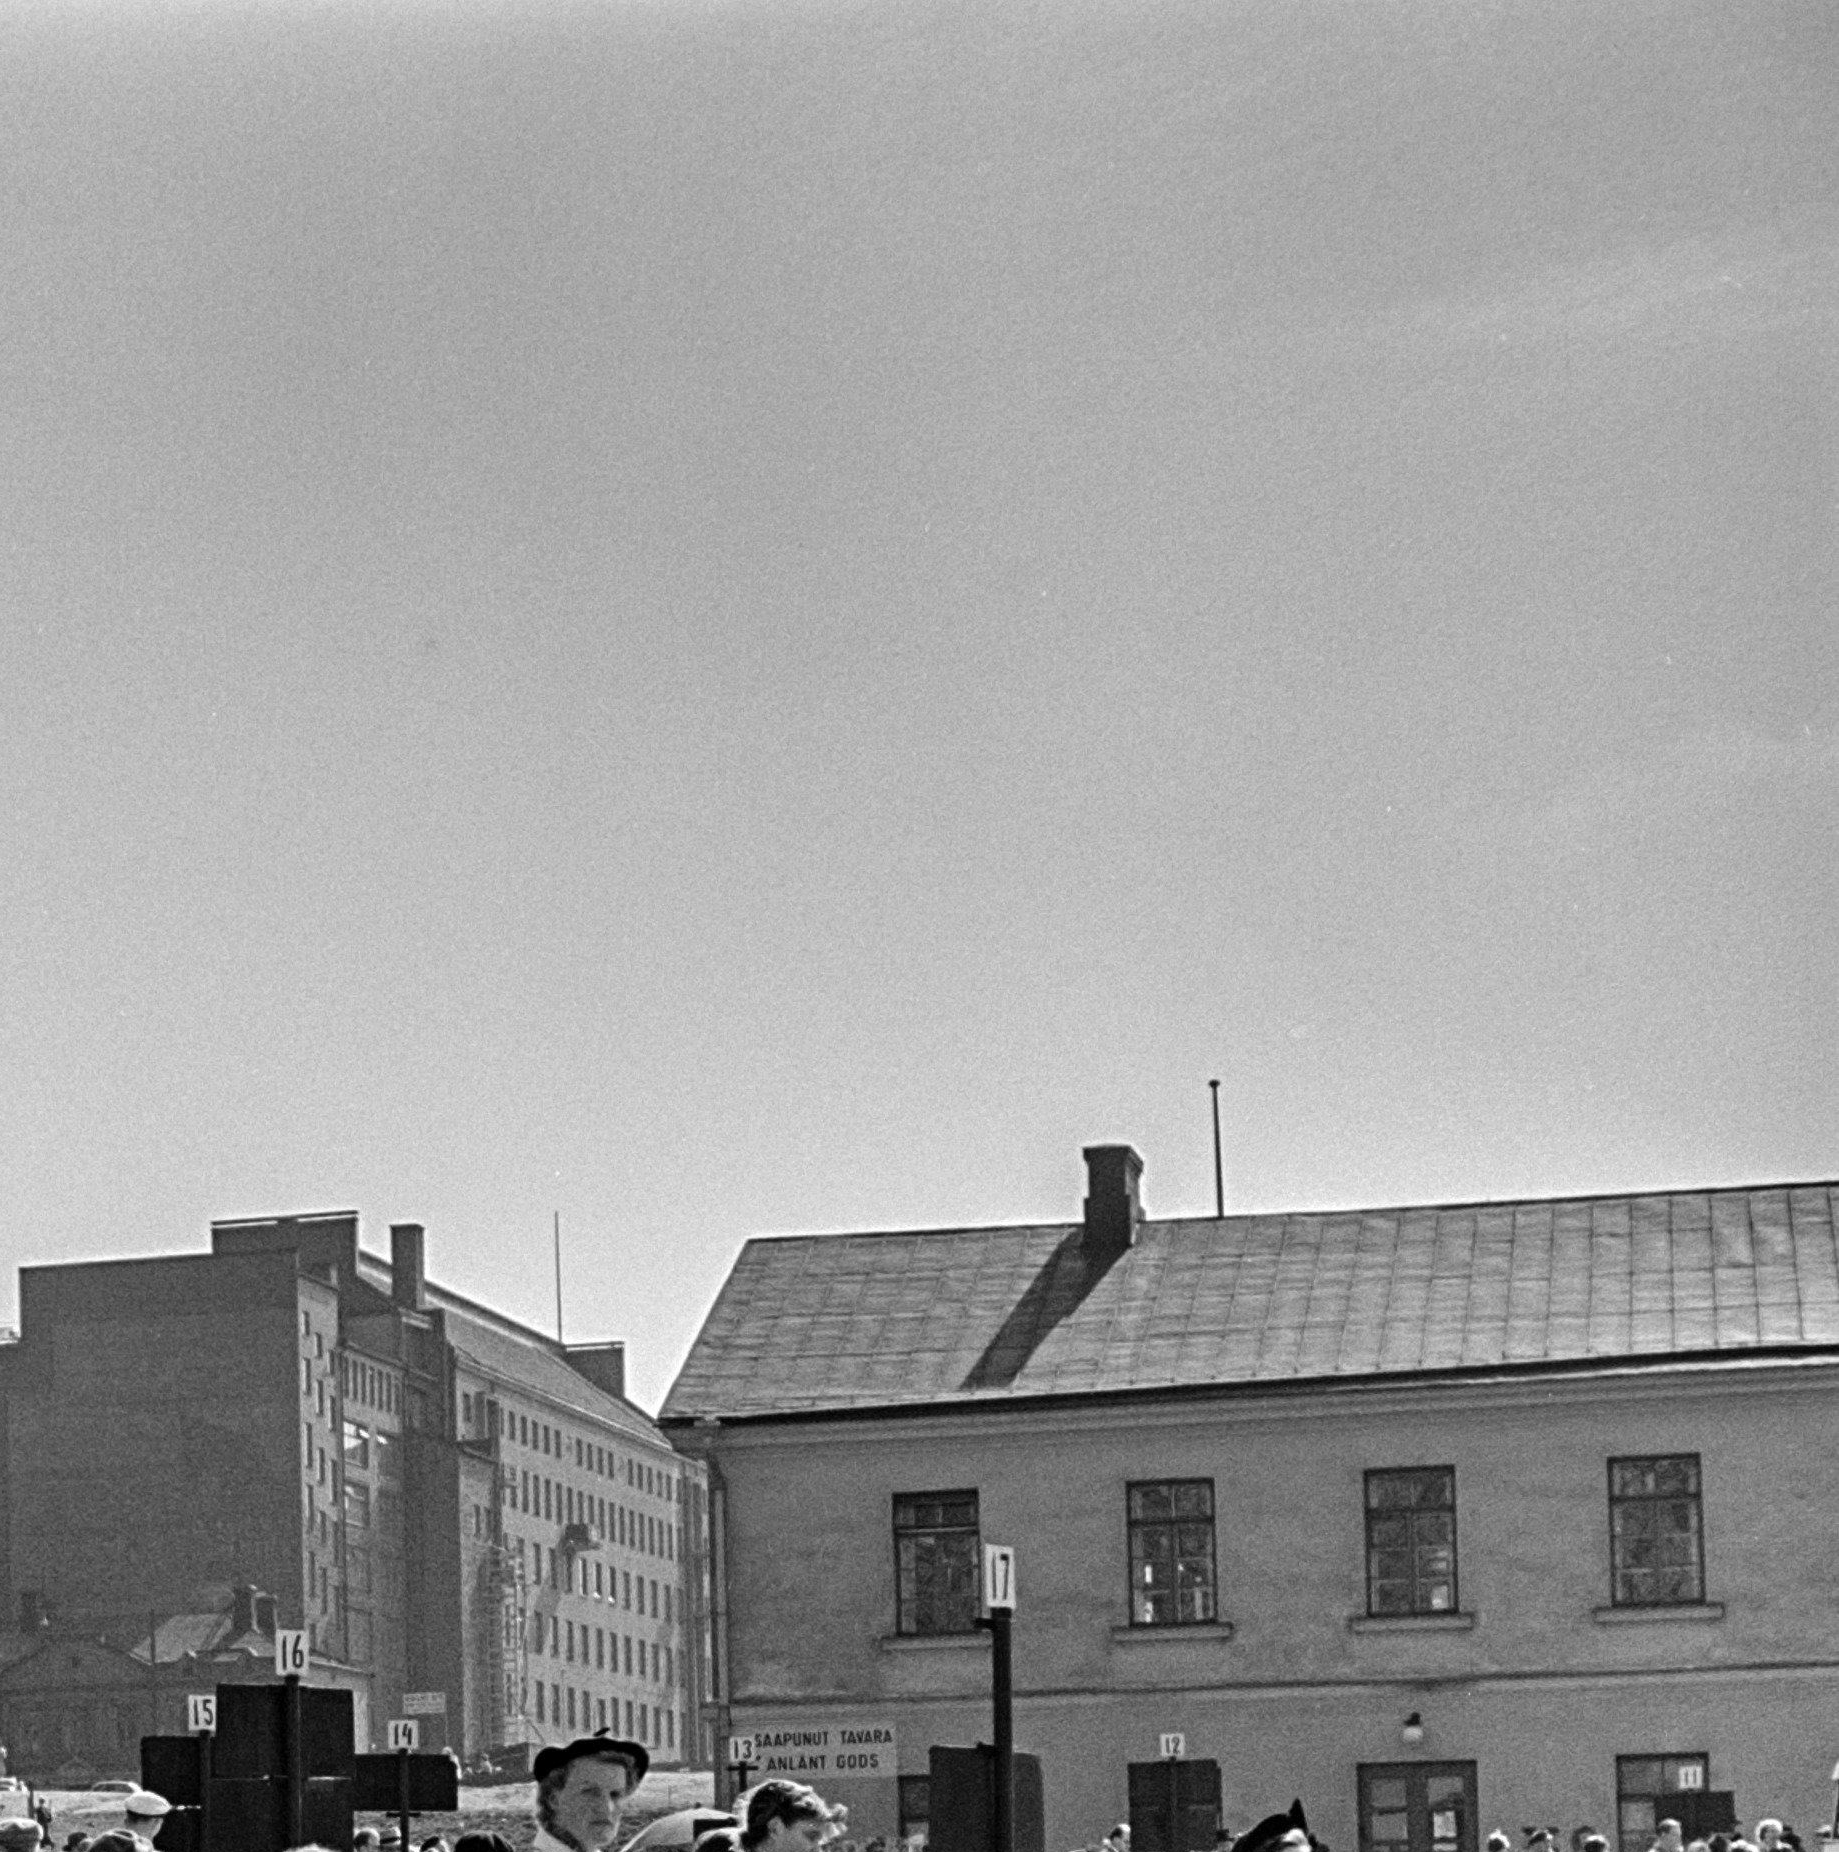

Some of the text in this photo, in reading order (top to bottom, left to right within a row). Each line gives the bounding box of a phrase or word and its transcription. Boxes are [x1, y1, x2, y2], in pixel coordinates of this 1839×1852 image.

[991, 1551, 1010, 1600] 17
[281, 1634, 304, 1670] 16
[193, 1699, 214, 1726] 15
[394, 1723, 413, 1747] 14
[754, 1729, 893, 1748] SAAPUNUT TAVARA
[1165, 1736, 1182, 1754] 12
[733, 1739, 753, 1760] 13
[836, 1753, 879, 1769] GODS
[1684, 1768, 1697, 1786] 11
